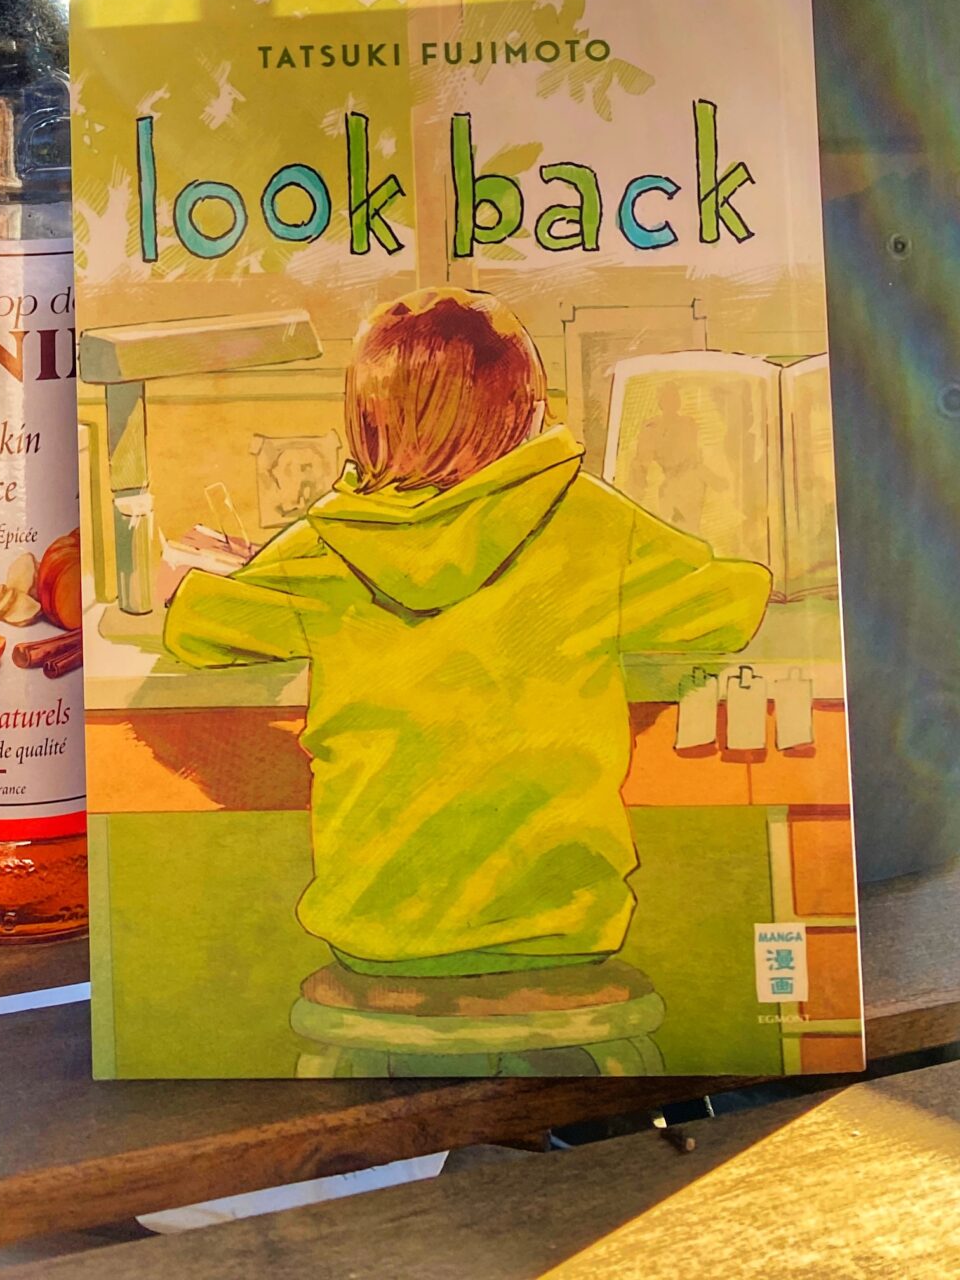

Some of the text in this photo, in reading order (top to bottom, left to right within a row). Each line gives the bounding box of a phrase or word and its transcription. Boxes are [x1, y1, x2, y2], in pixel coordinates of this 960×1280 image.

[258, 39, 611, 69] TATSUKI FUJIMOTO
[136, 99, 755, 263] look back
[50, 286, 76, 315] d
[15, 736, 68, 764] qualité
[758, 931, 803, 942] MANGA
